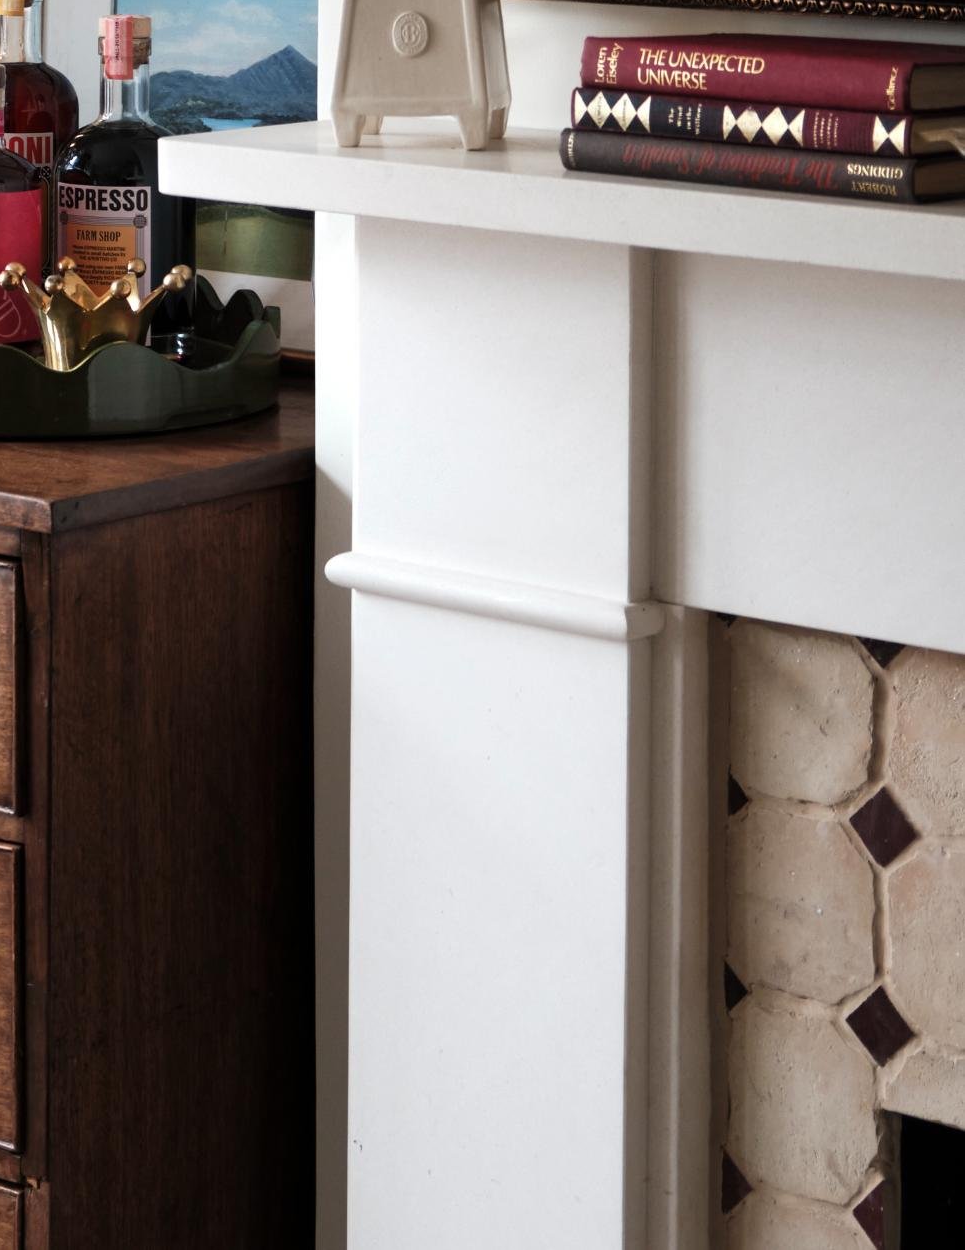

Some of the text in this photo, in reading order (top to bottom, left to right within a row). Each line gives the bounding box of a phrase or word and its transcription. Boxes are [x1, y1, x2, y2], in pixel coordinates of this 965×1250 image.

[595, 47, 608, 83] Loren
[606, 42, 624, 85] Eiseley
[639, 48, 765, 75] THE UNEXPECTED
[637, 67, 708, 90] UNIVERSE
[9, 136, 52, 165] ONI
[697, 146, 716, 175] of
[717, 151, 803, 186] Tradition
[803, 159, 839, 190] The
[846, 163, 904, 180] GIDDINGS
[58, 185, 148, 211] ESPRESSO
[850, 180, 898, 197] ROBERT
[76, 229, 121, 242] FARM SHOP
